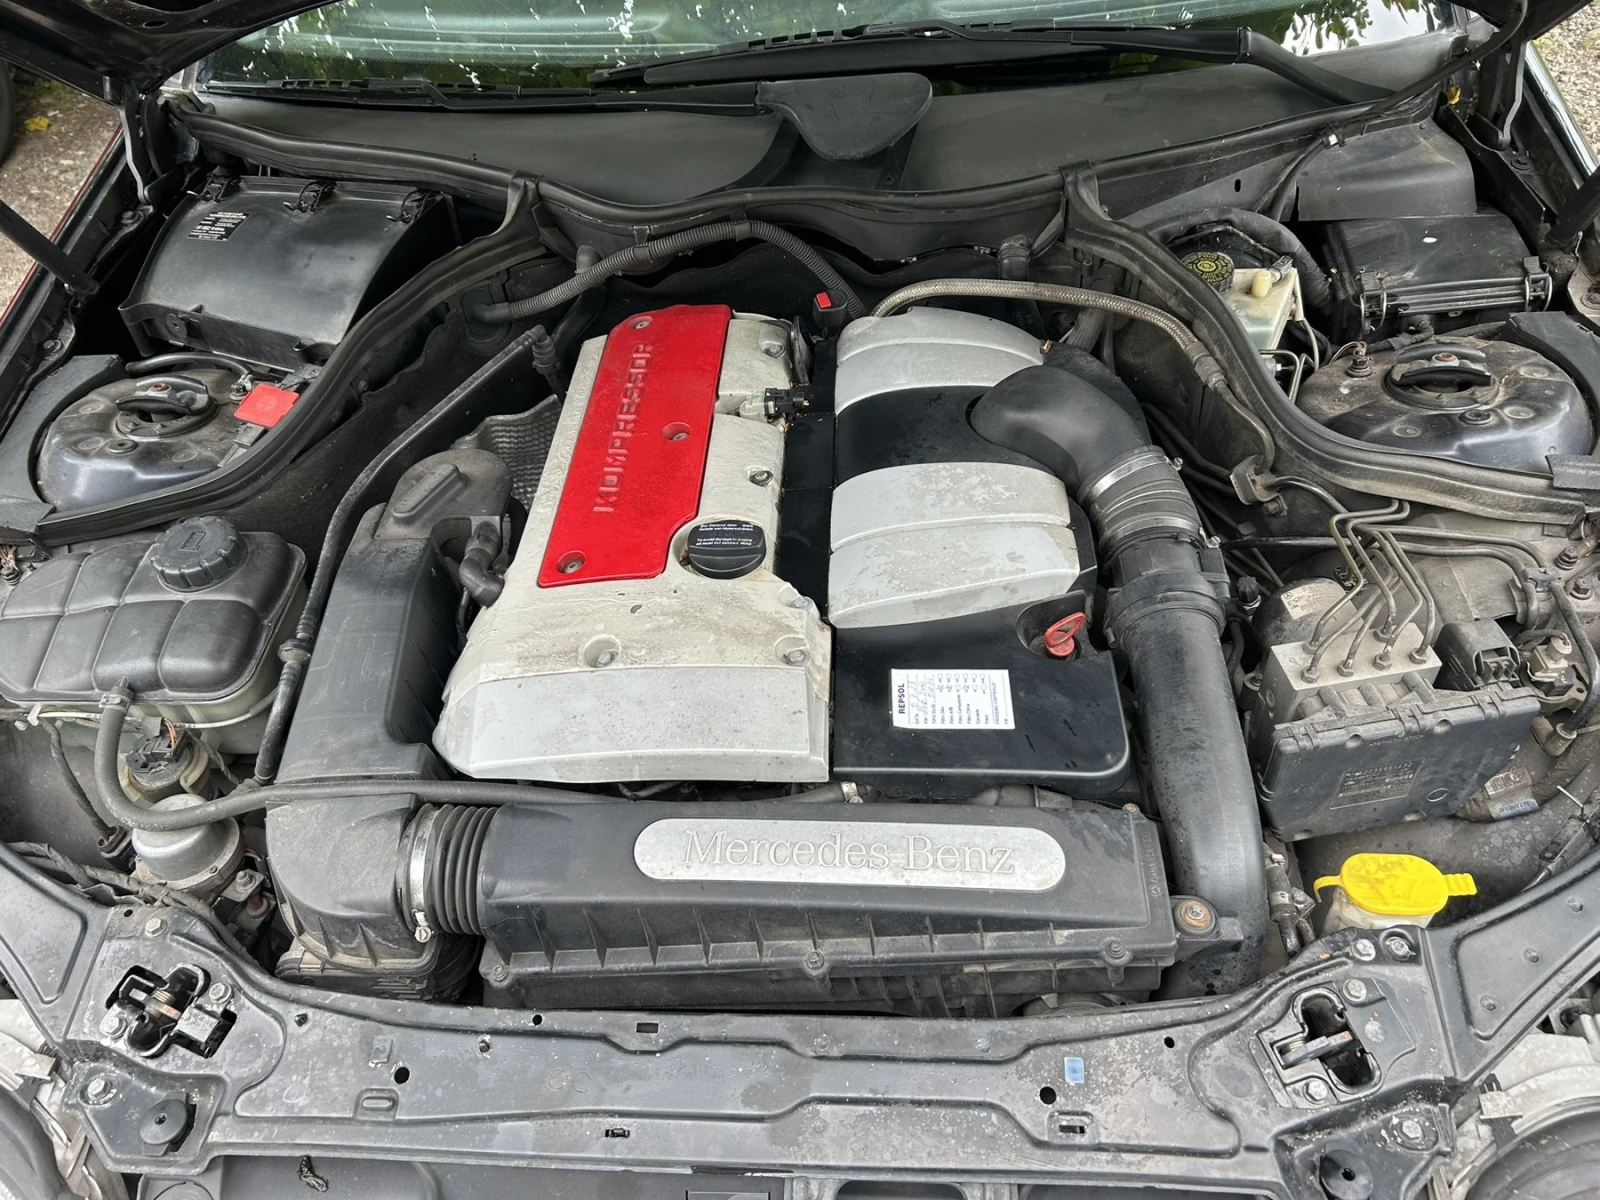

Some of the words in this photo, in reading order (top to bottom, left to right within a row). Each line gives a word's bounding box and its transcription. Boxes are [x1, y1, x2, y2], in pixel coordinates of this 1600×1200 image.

[593, 342, 653, 512] KOMPRESSOR
[898, 683, 906, 714] REPSOL
[682, 829, 1016, 875] Mercedes-Benz
